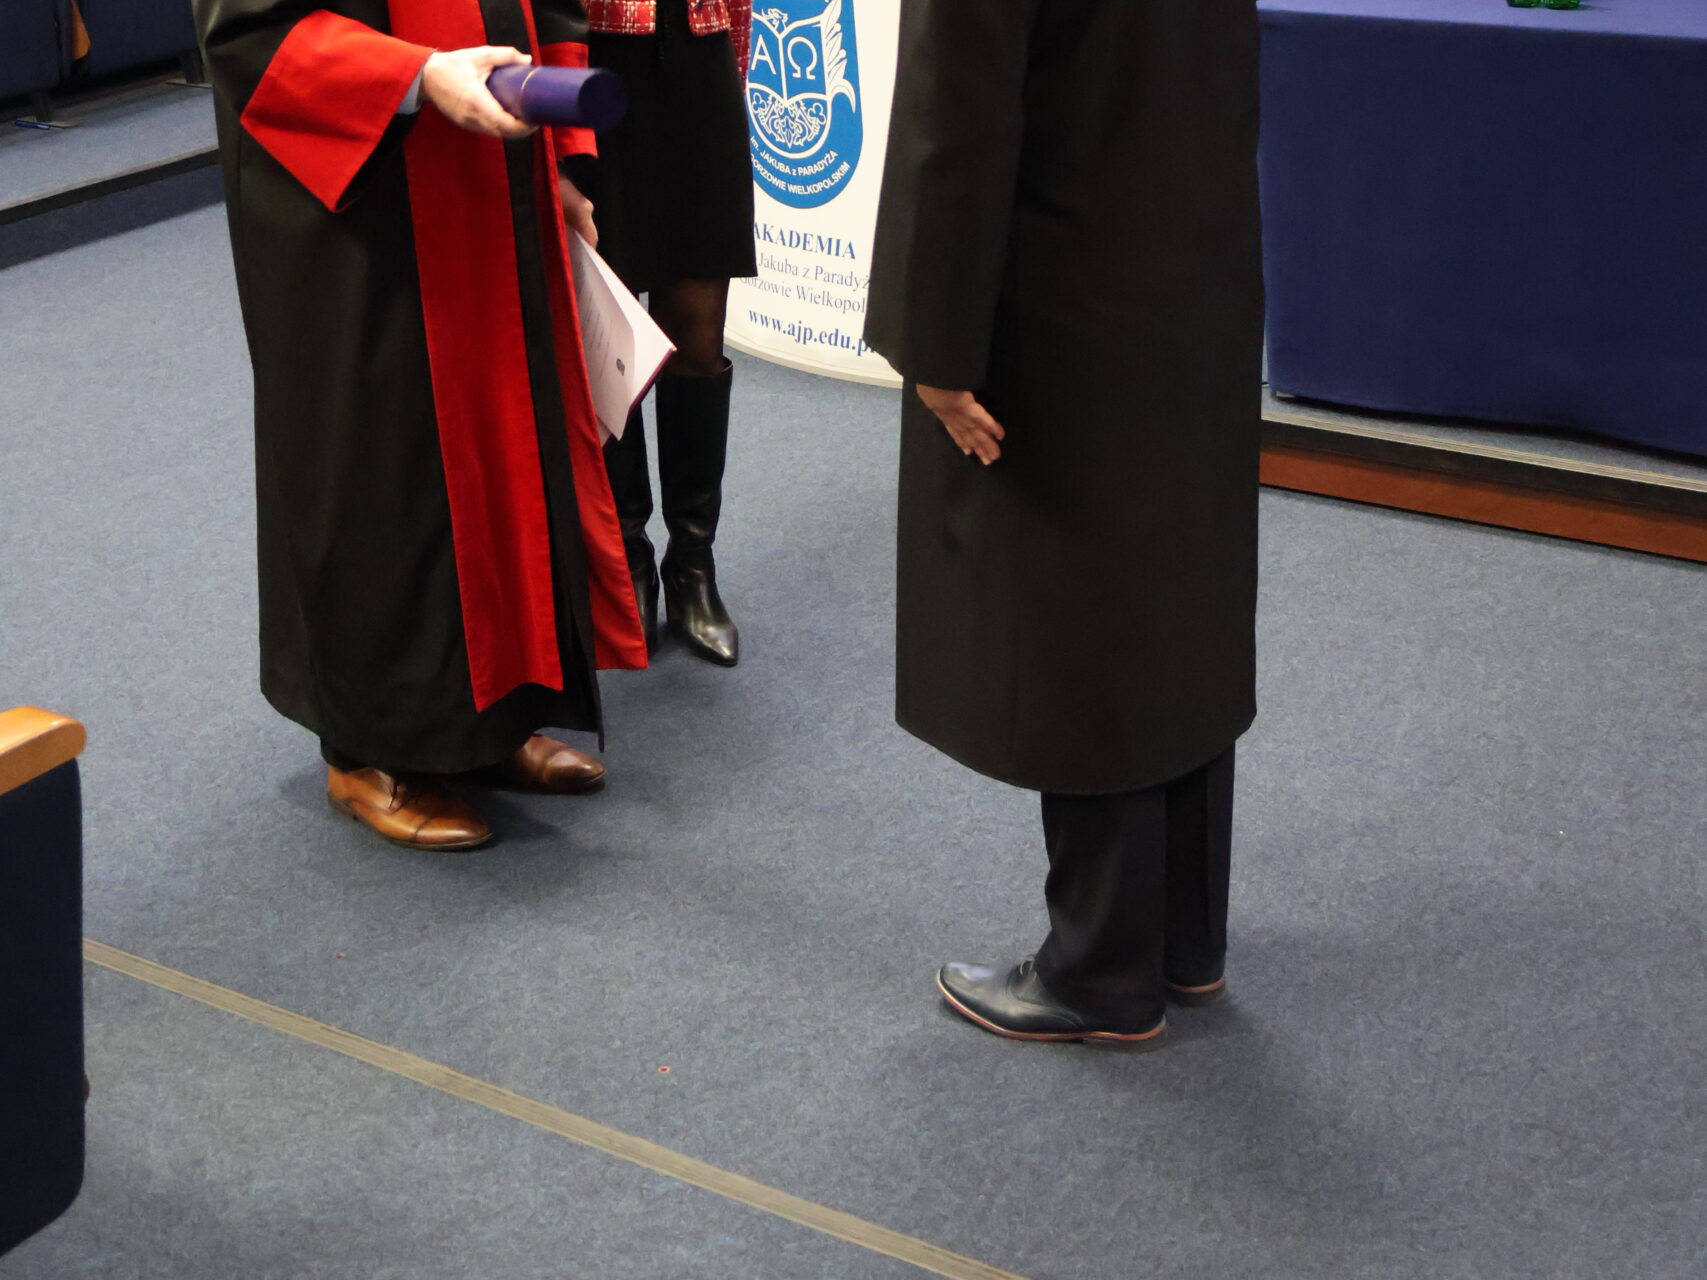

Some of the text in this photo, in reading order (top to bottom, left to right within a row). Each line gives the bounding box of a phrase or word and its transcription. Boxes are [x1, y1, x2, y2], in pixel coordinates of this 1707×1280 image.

[760, 149, 791, 175] JAKUBA
[787, 160, 851, 195] WIELKOPOLSKIM
[758, 252, 870, 292] Jakuba z Paradyż
[796, 284, 866, 315] Wielkopol
[748, 310, 876, 357] www.ajp.edu.p
